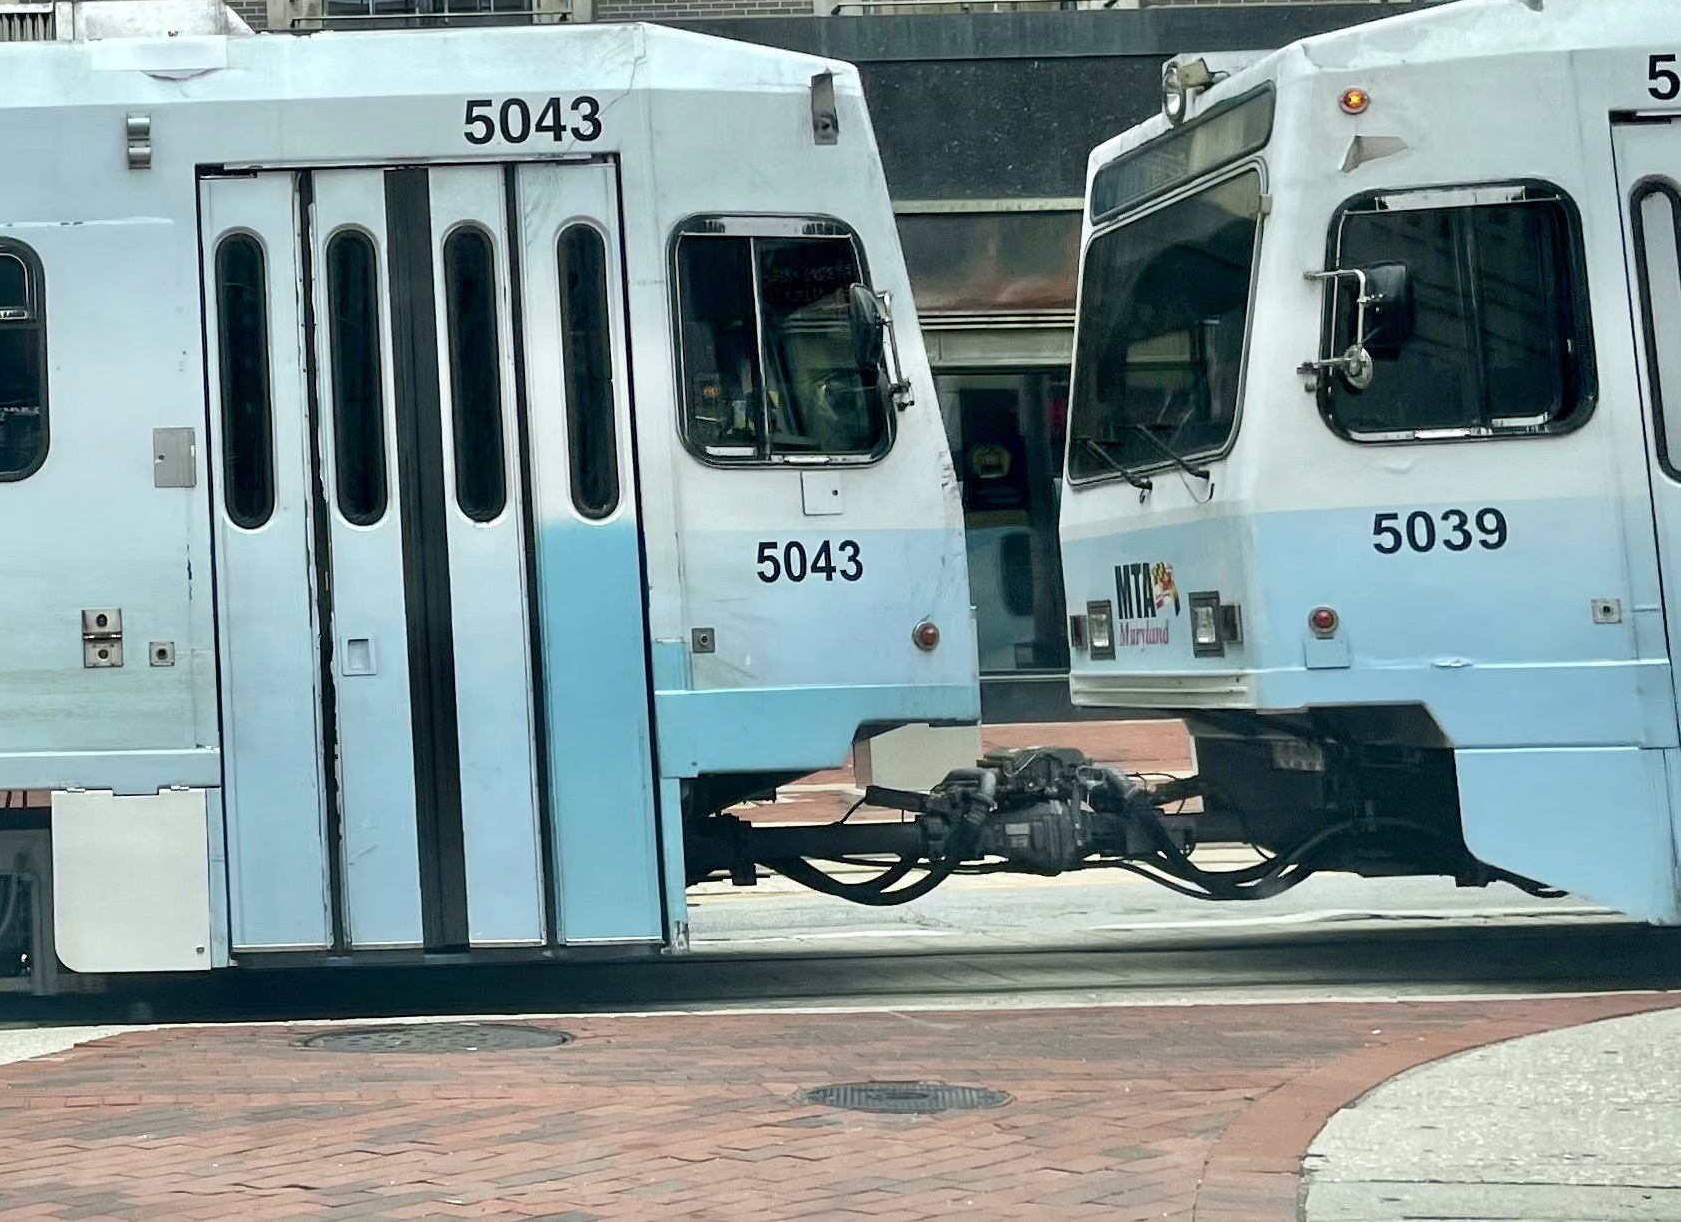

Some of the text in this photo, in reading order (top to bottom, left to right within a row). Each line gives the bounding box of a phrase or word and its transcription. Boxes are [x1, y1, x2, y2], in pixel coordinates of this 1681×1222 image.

[1648, 53, 1681, 101] 5
[463, 95, 602, 145] 5043
[1374, 508, 1508, 555] 5039
[756, 539, 864, 584] 5043
[1114, 562, 1157, 620] MTA
[1119, 619, 1170, 647] Maryland
